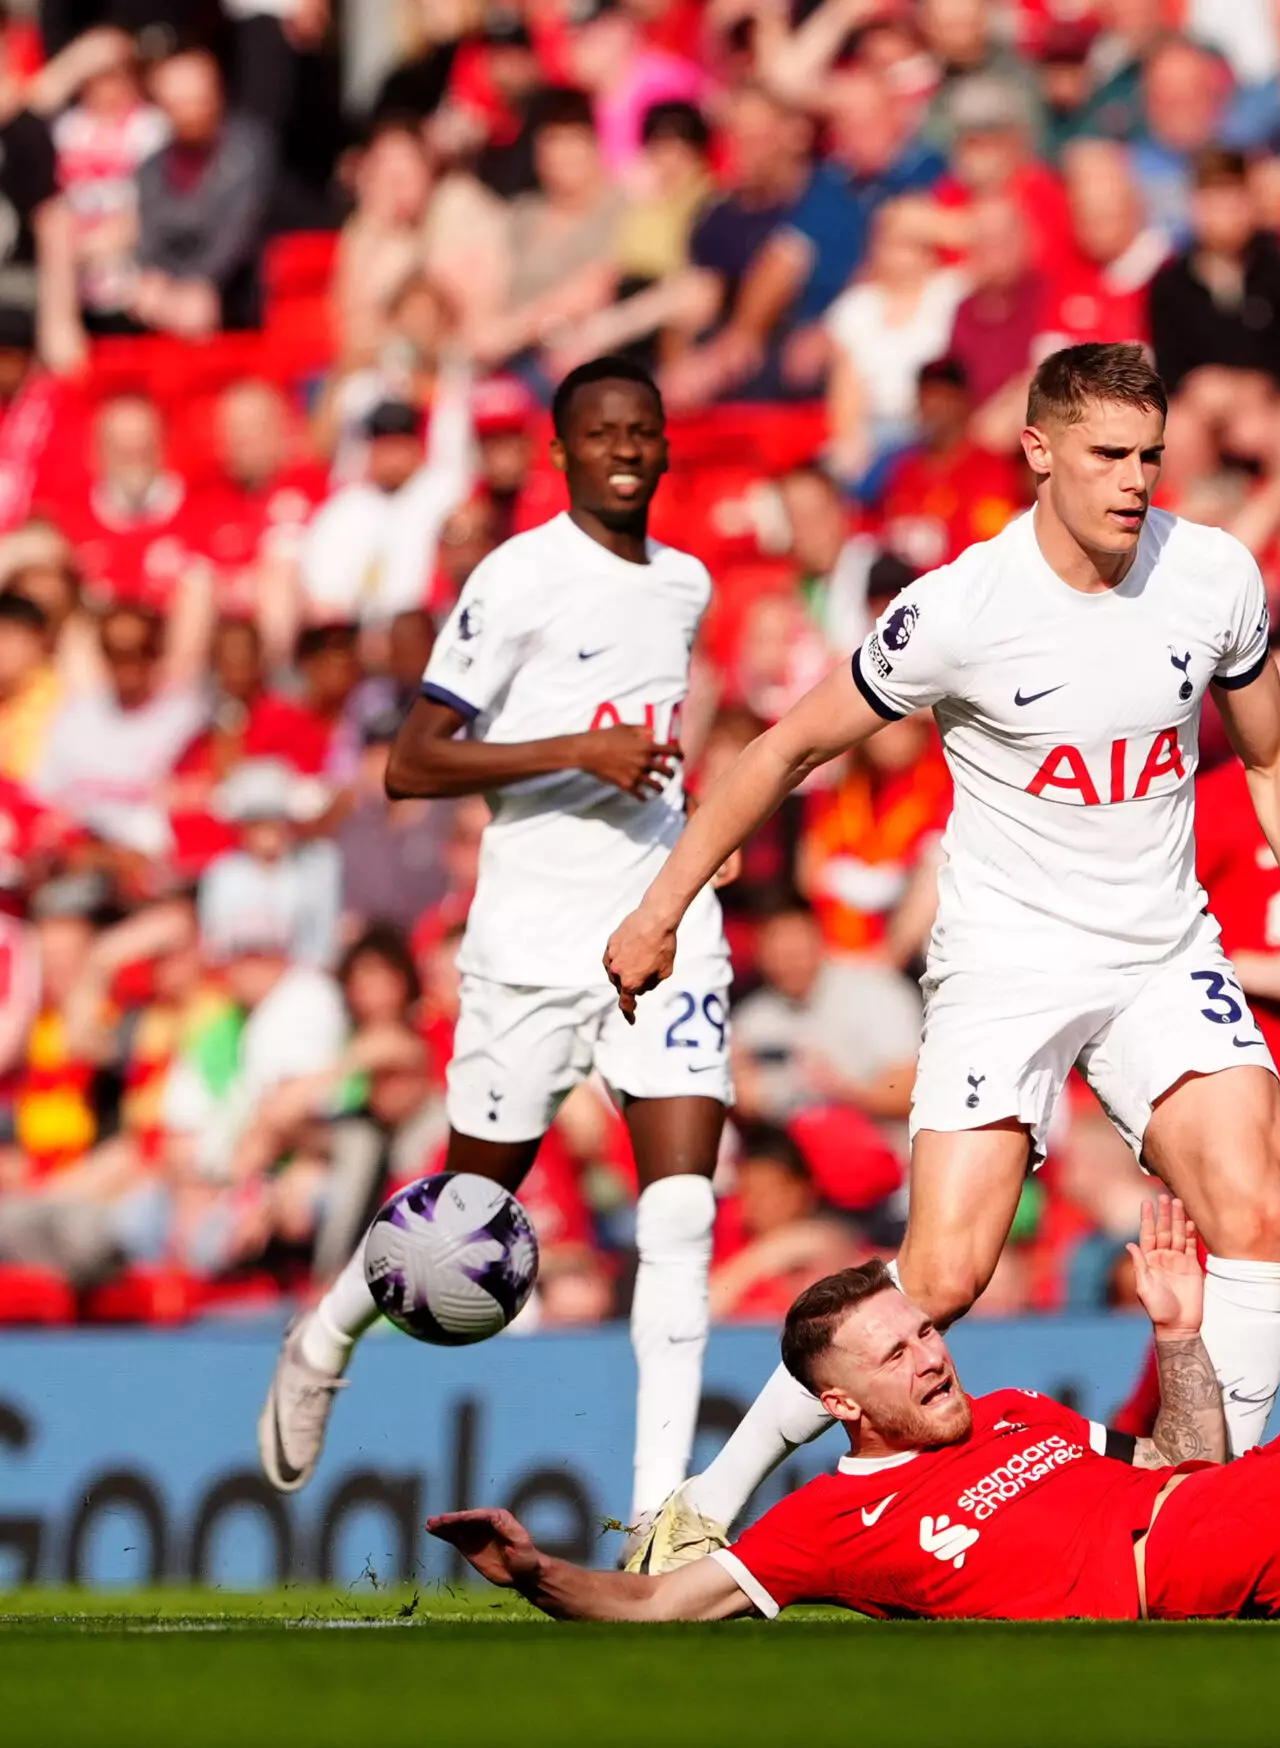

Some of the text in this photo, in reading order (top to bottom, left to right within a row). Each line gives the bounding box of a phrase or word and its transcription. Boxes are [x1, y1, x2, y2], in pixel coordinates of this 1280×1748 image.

[1024, 727, 1186, 806] AIA
[664, 990, 726, 1053] 29
[1190, 970, 1258, 1030] 3
